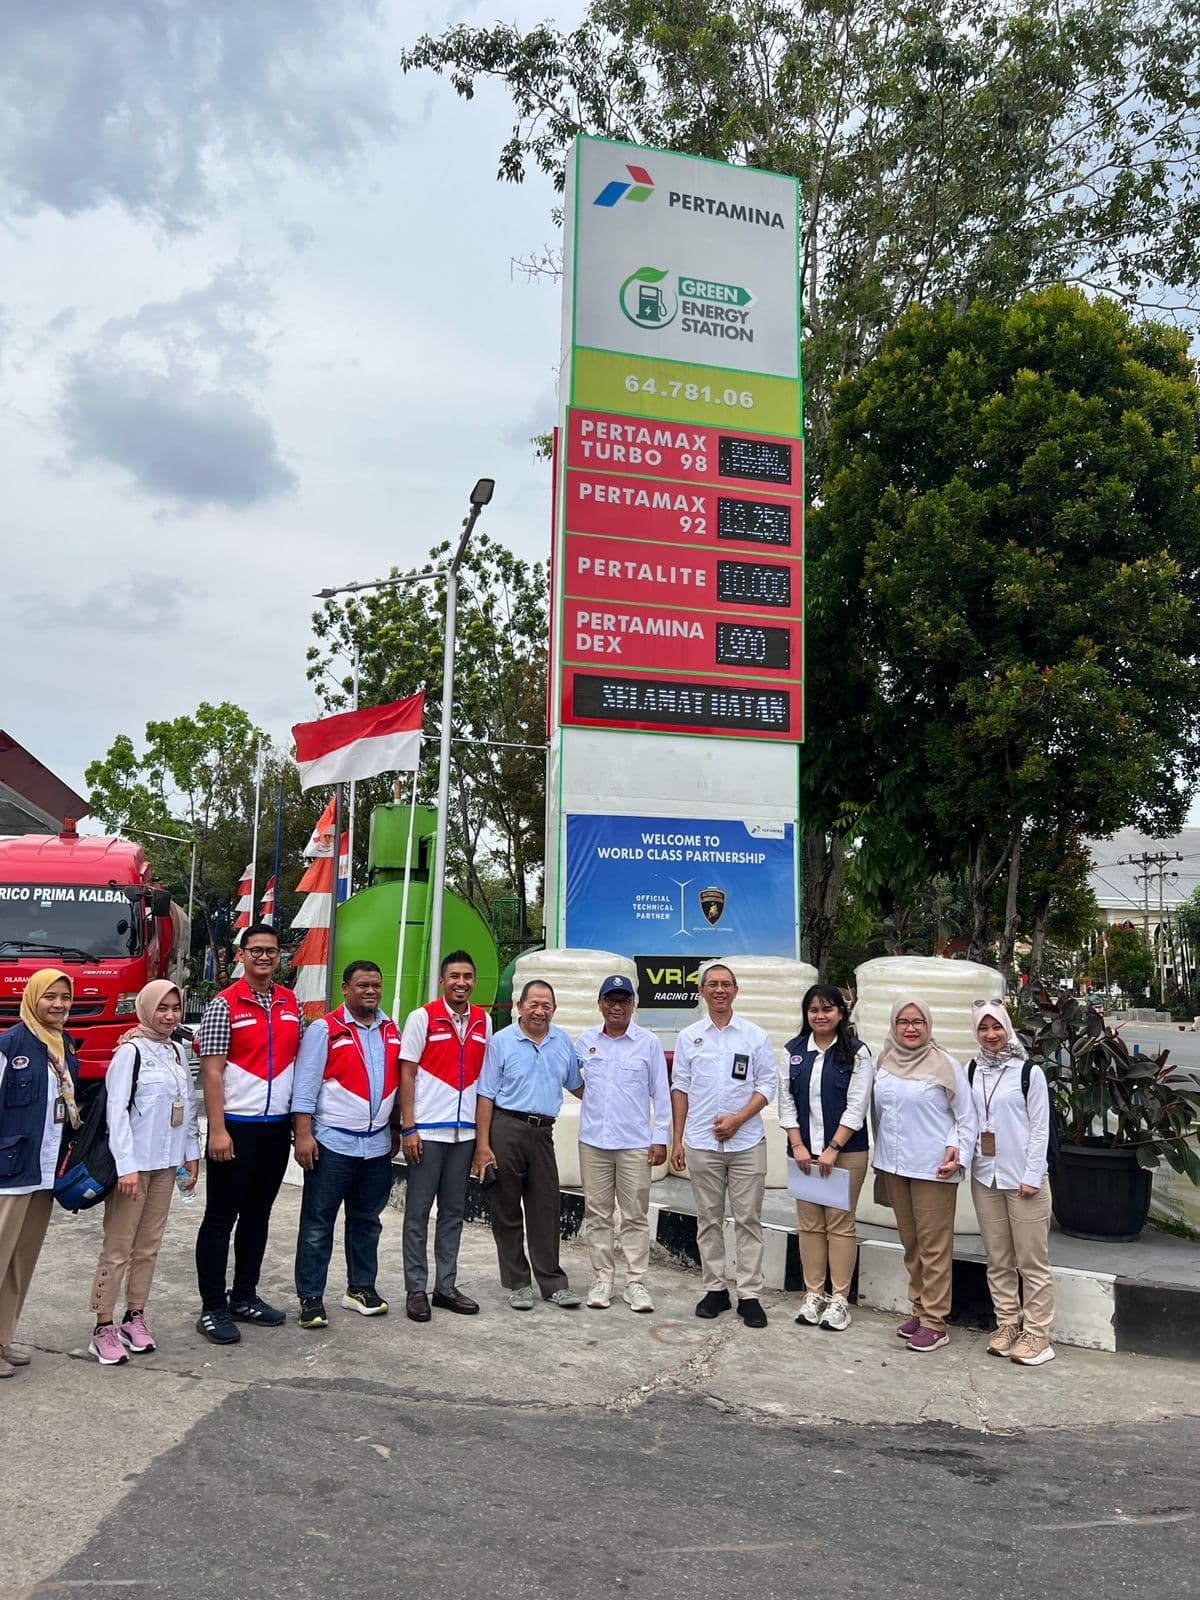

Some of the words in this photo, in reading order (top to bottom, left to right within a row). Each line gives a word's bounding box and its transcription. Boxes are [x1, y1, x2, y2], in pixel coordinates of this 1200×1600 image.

[669, 192, 784, 229] PERTAMINA
[682, 279, 738, 302] GREEN
[682, 300, 750, 324] ENERGY
[681, 318, 754, 342] STATION
[624, 375, 754, 408] 64.781.06
[581, 420, 707, 452] PERTAMAX
[581, 441, 662, 466] TURBO
[680, 455, 708, 472] 98
[579, 483, 706, 514] PERTAMAX
[679, 516, 707, 534] 92
[578, 557, 706, 587] PERTALITE
[576, 611, 704, 639] PERTAMINA
[576, 634, 622, 654] DEX
[641, 833, 701, 847] WELCOME
[704, 836, 720, 847] TO
[597, 847, 643, 860] WORLD
[647, 849, 682, 861] CLASS
[686, 850, 766, 864] PARTNERSHIP
[33, 888, 75, 901] PRIMA
[636, 912, 670, 920] PARTNER
[654, 992, 688, 1000] RACING
